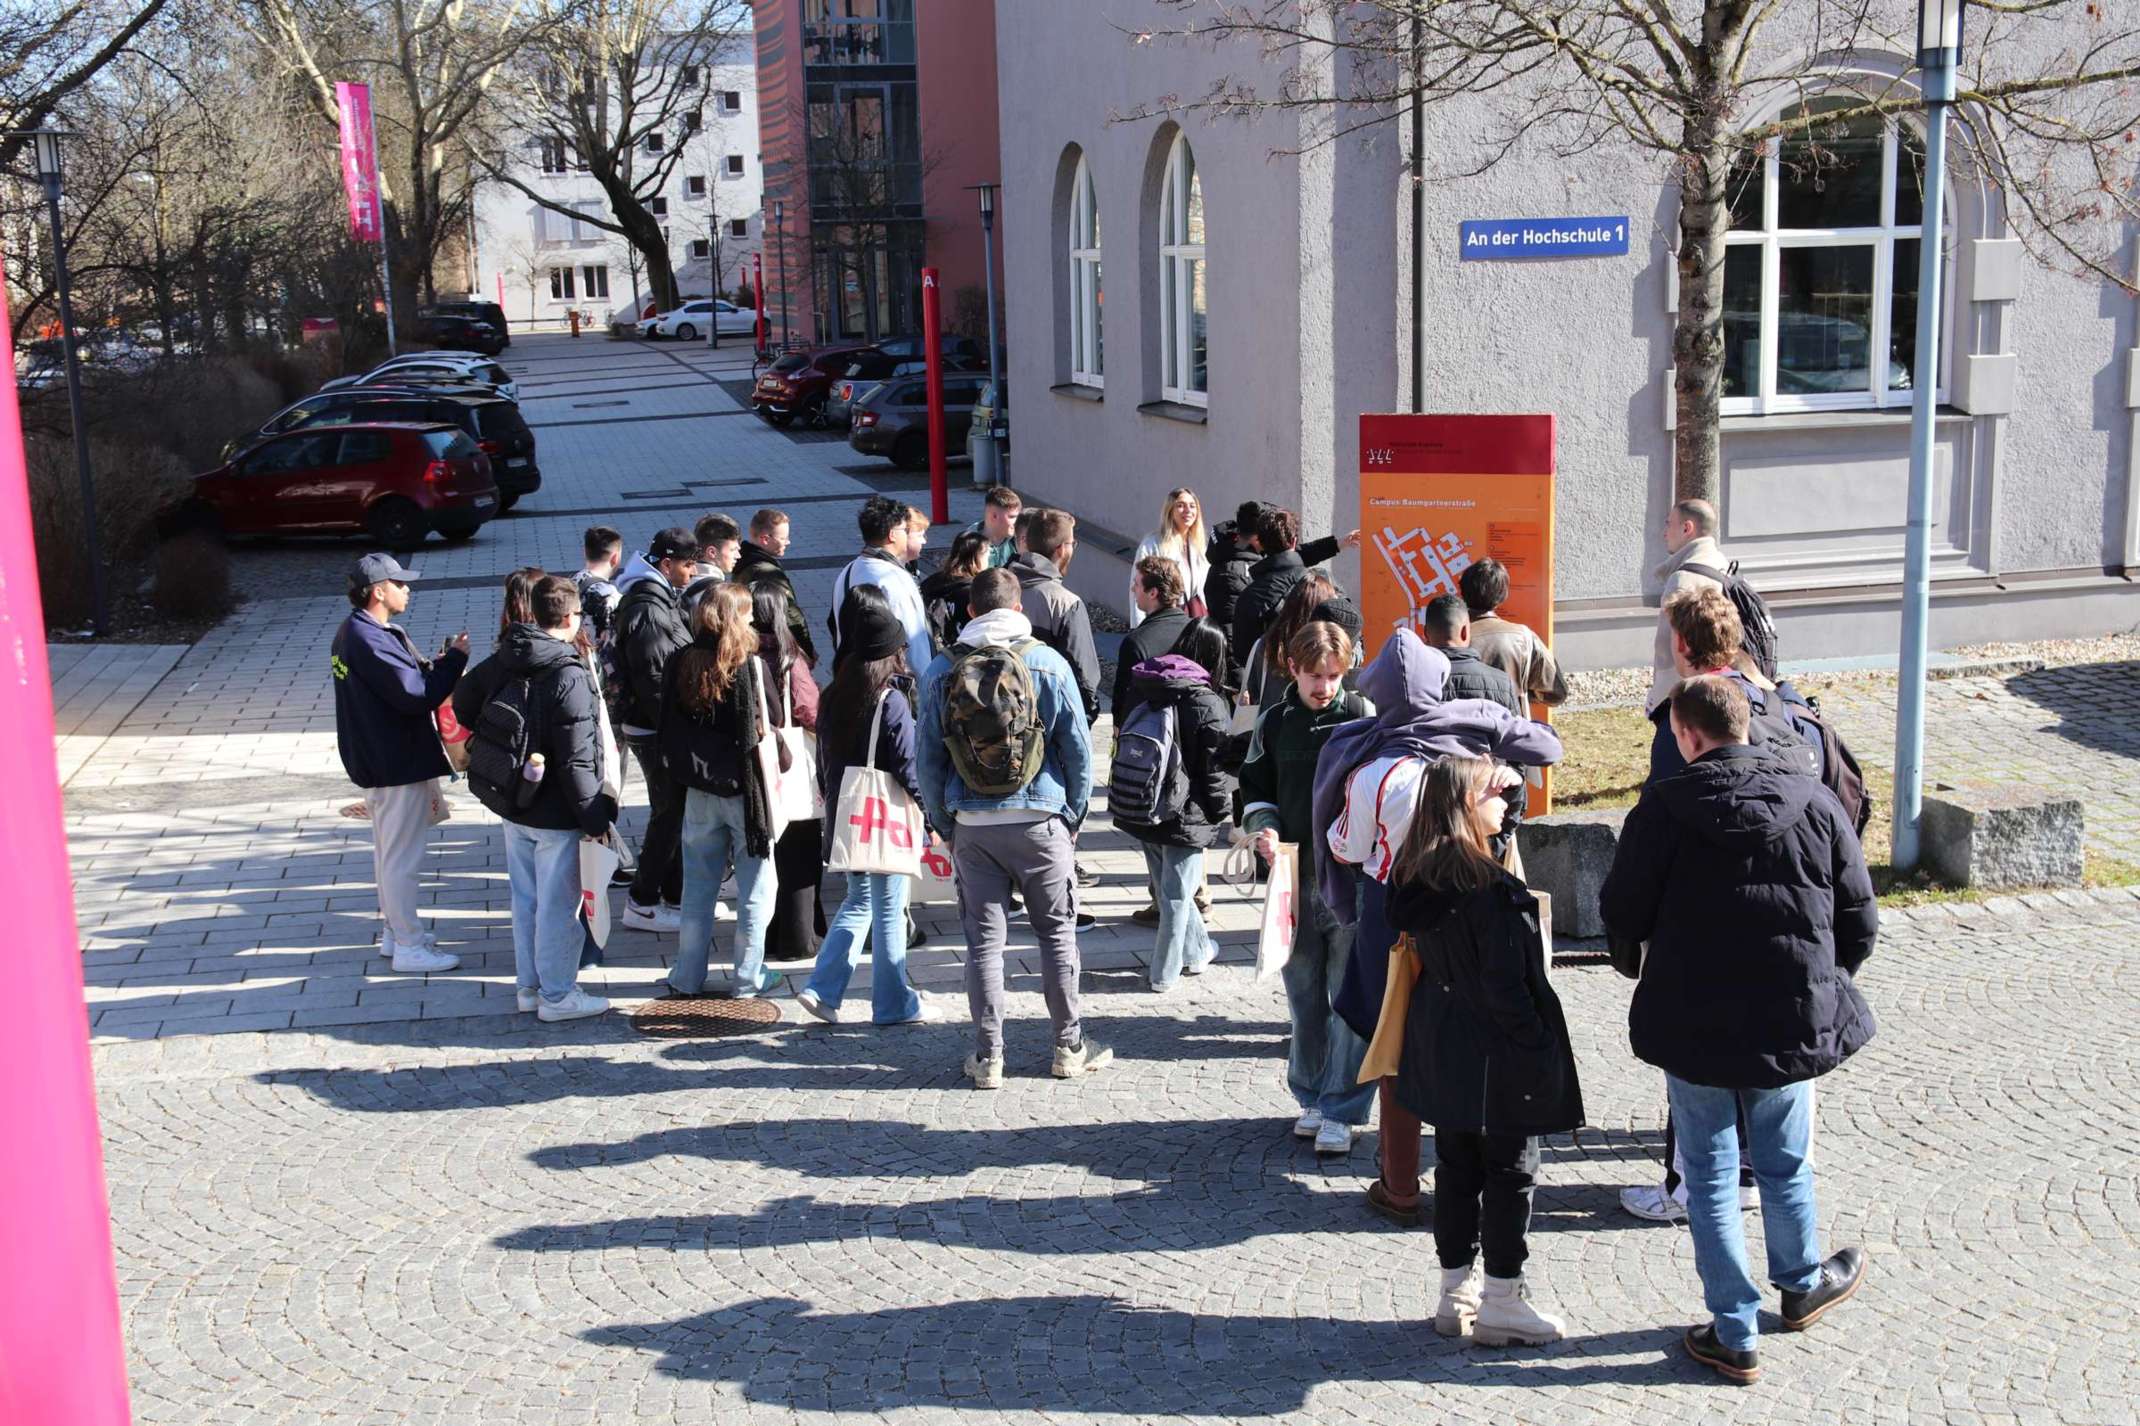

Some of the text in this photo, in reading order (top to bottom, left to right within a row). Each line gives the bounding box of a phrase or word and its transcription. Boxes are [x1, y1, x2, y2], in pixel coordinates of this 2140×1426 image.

[1467, 224, 1624, 246] An der Hochschule 1
[923, 275, 935, 287] A
[1369, 498, 1399, 506] Campus
